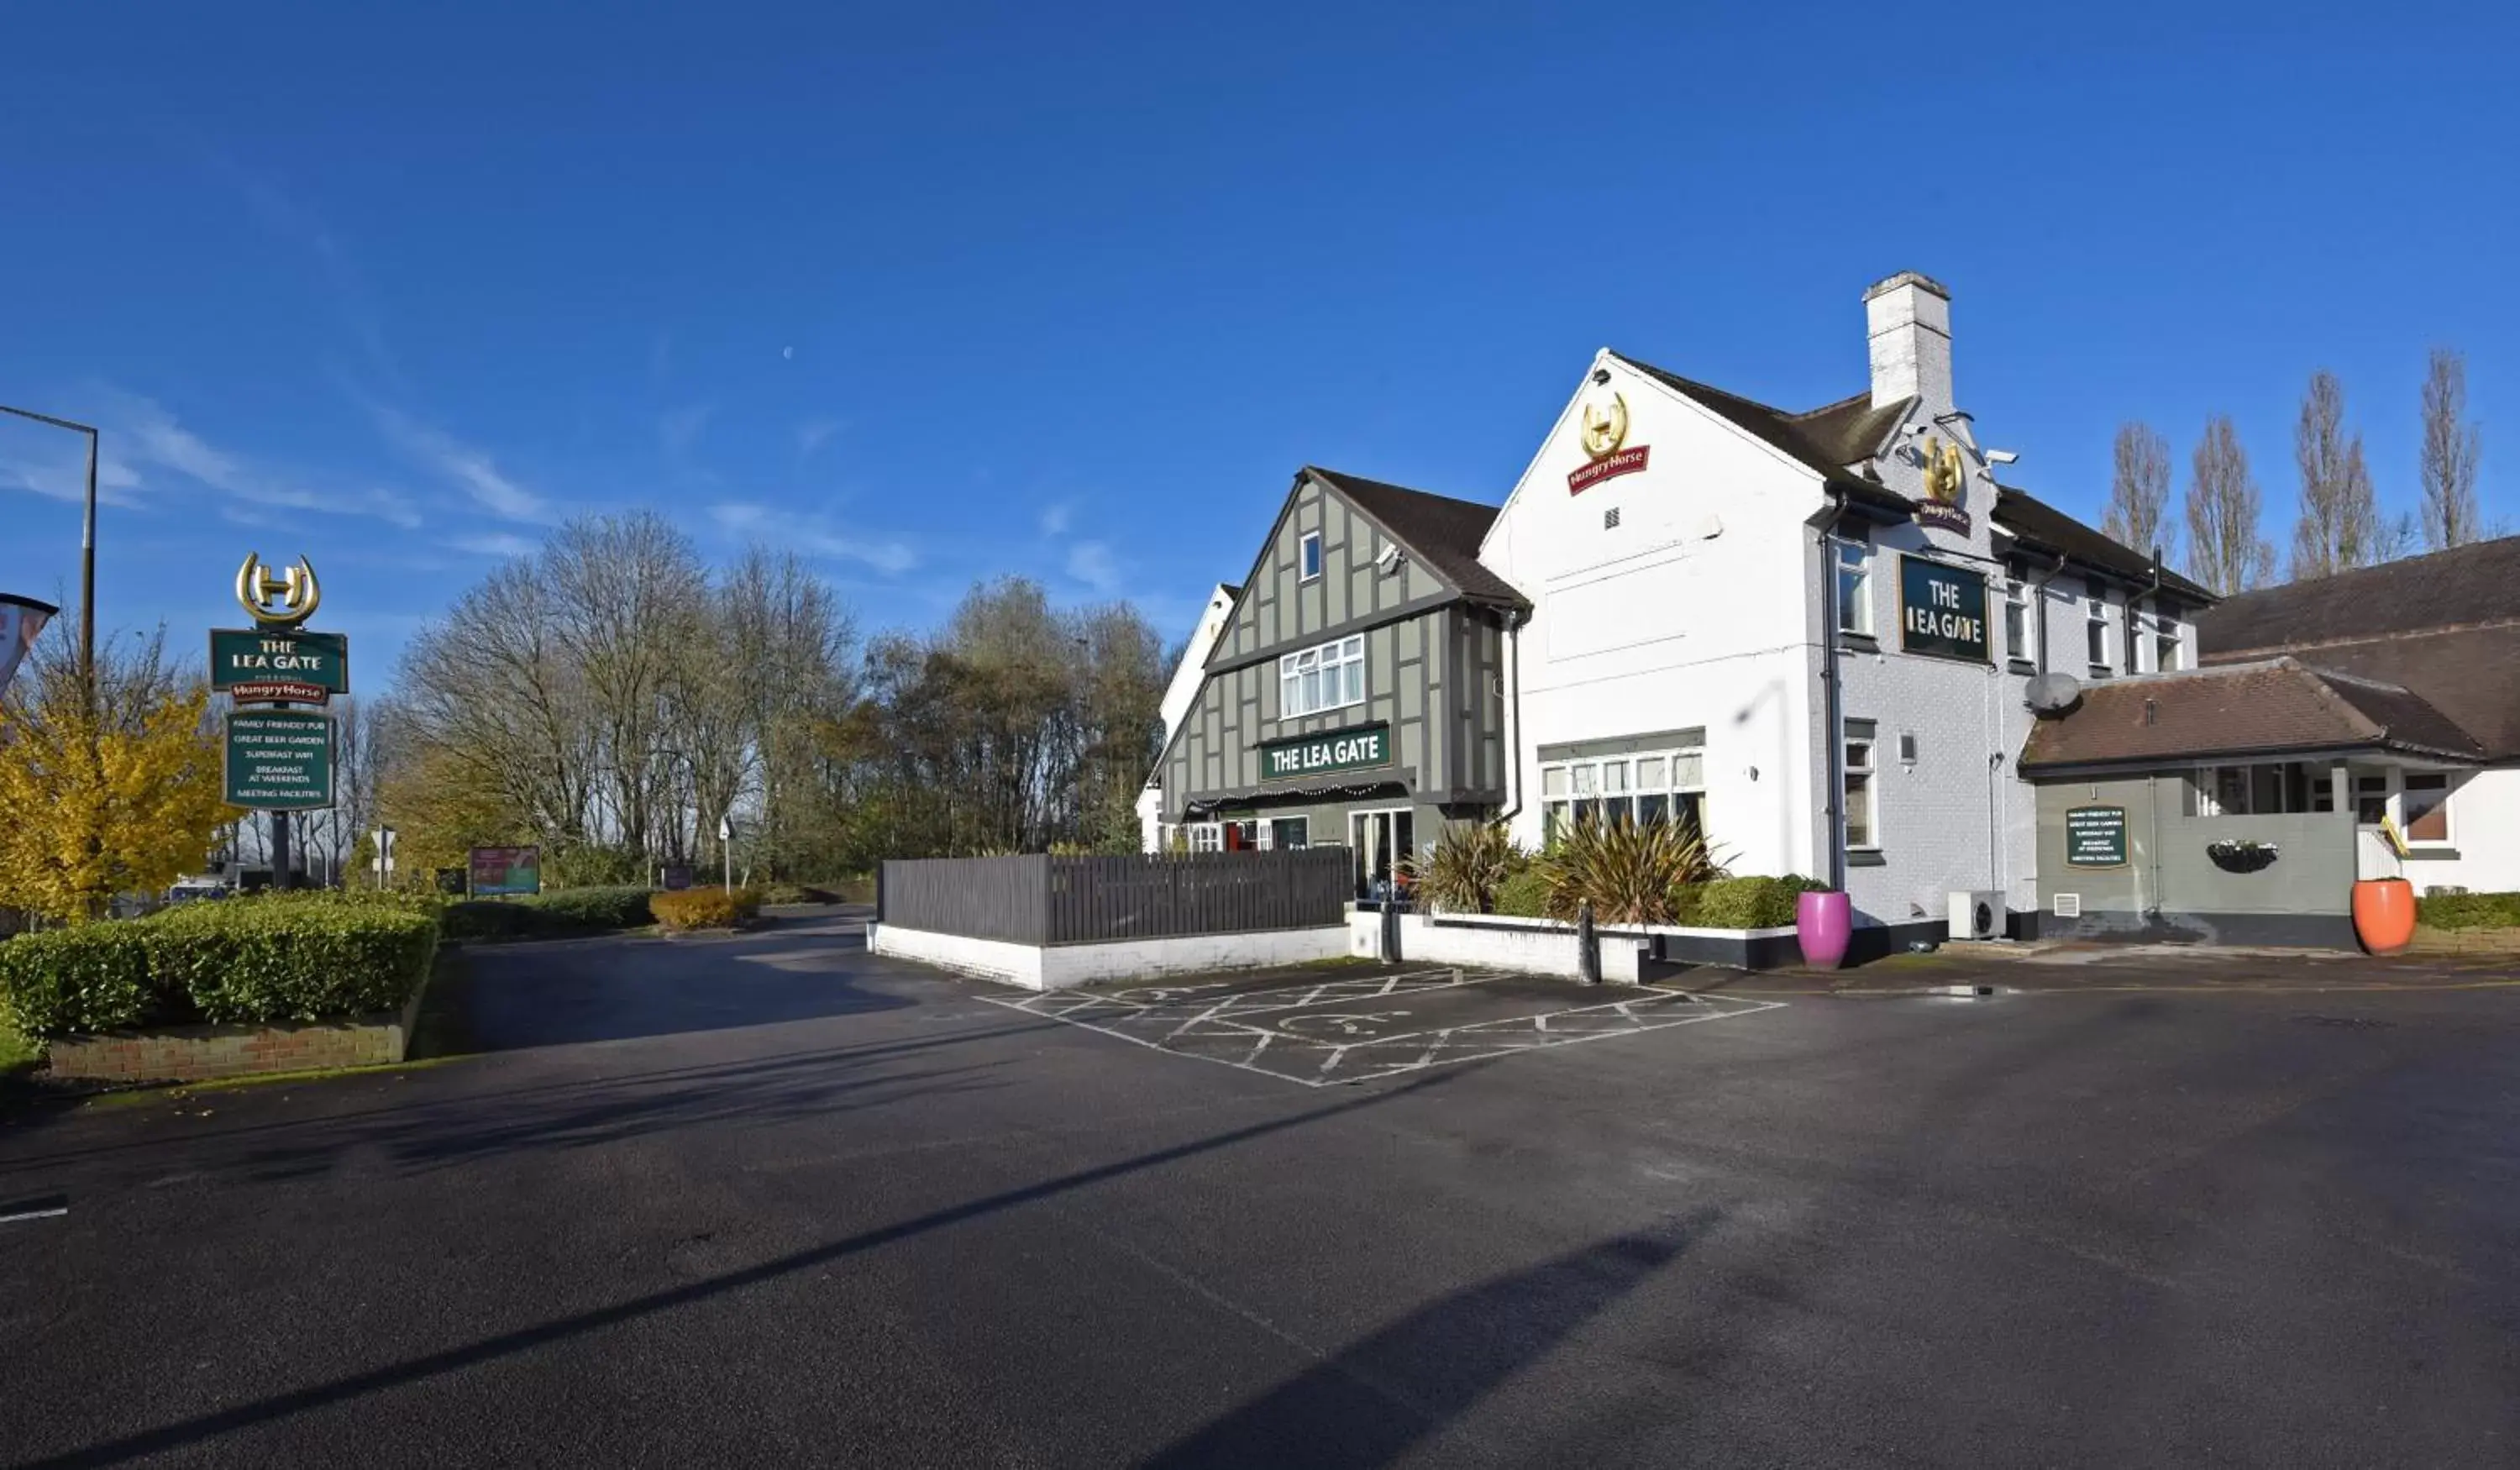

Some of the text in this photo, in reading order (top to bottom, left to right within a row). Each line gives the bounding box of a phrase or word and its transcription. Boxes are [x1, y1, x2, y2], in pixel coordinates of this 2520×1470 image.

[1928, 579, 1960, 609] THE
[1906, 606, 1982, 643] LEA GATE
[260, 639, 297, 654] THE
[232, 654, 323, 671] LEA GATE
[234, 720, 265, 728] FAMILY
[266, 720, 306, 729] FRIENDLY
[234, 735, 325, 745] GREAT BEER GARDEN
[245, 750, 293, 759] SUPERFAST
[1271, 735, 1378, 772] THE LEA GATE
[255, 765, 303, 774] BREAKFAST
[262, 774, 310, 783] WEEKENDS
